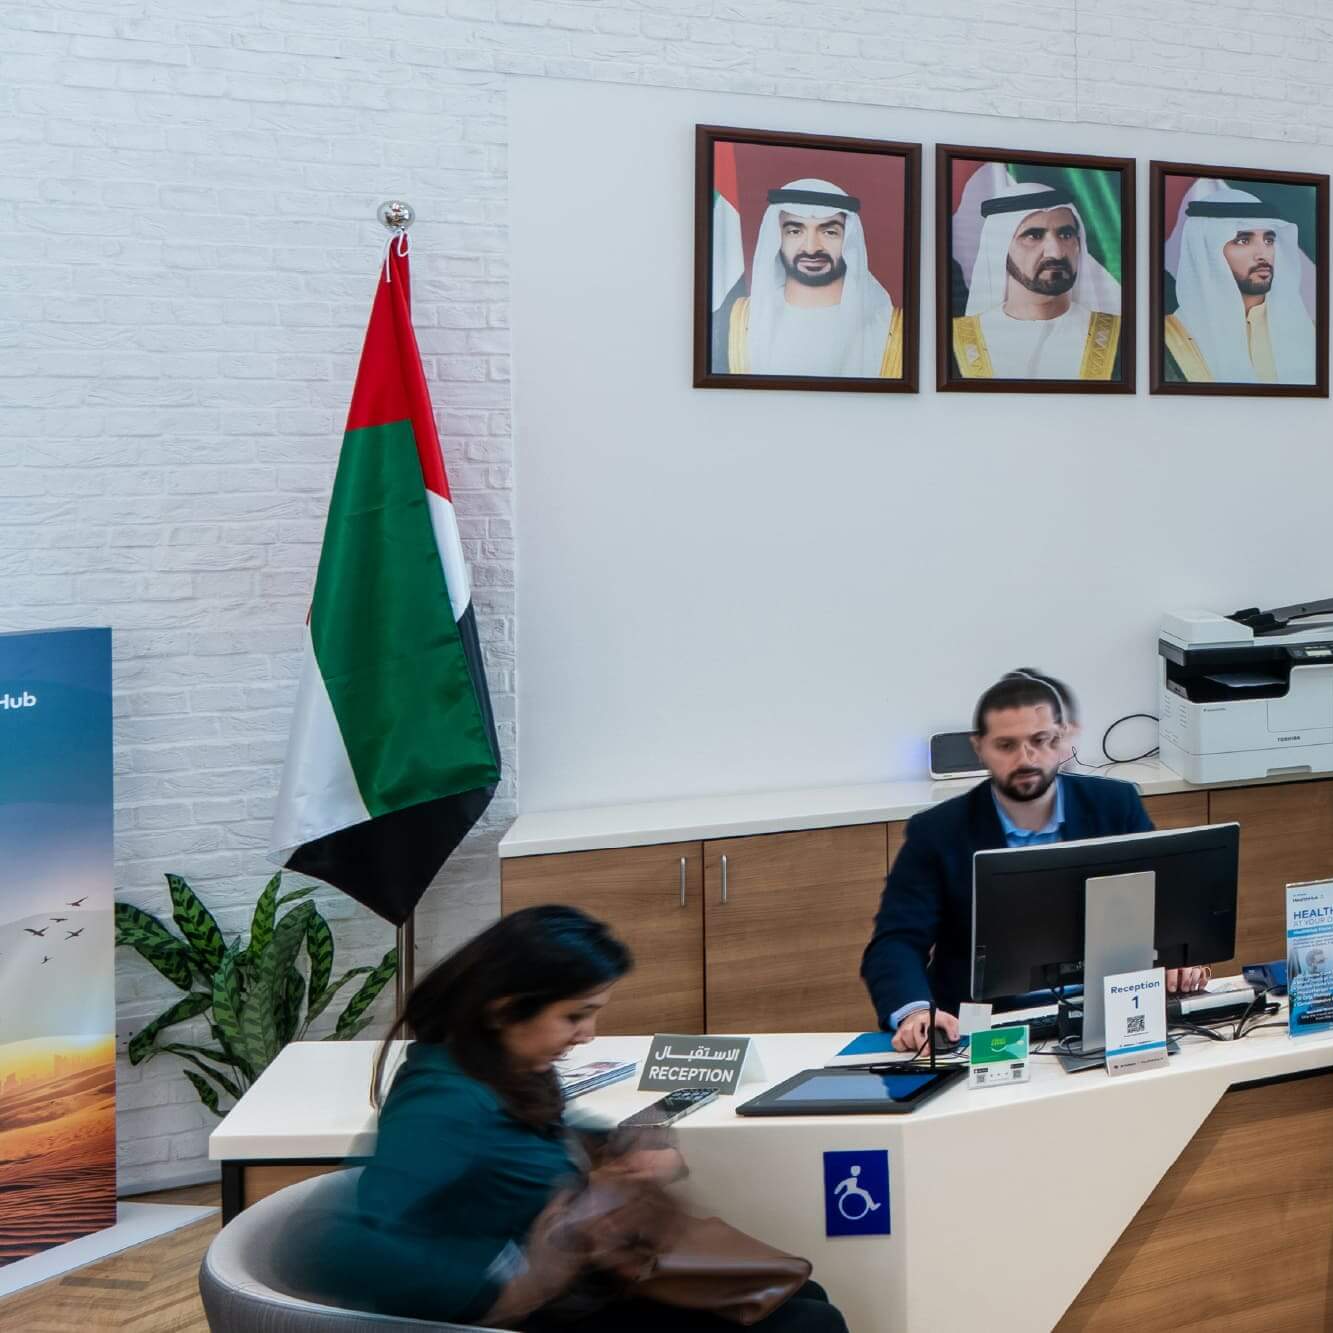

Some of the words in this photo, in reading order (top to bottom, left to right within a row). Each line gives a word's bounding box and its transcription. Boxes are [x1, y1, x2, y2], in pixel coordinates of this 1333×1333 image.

[1110, 980, 1161, 994] Reception
[1131, 995, 1139, 1009] 1
[648, 1066, 735, 1083] RECEPTION
